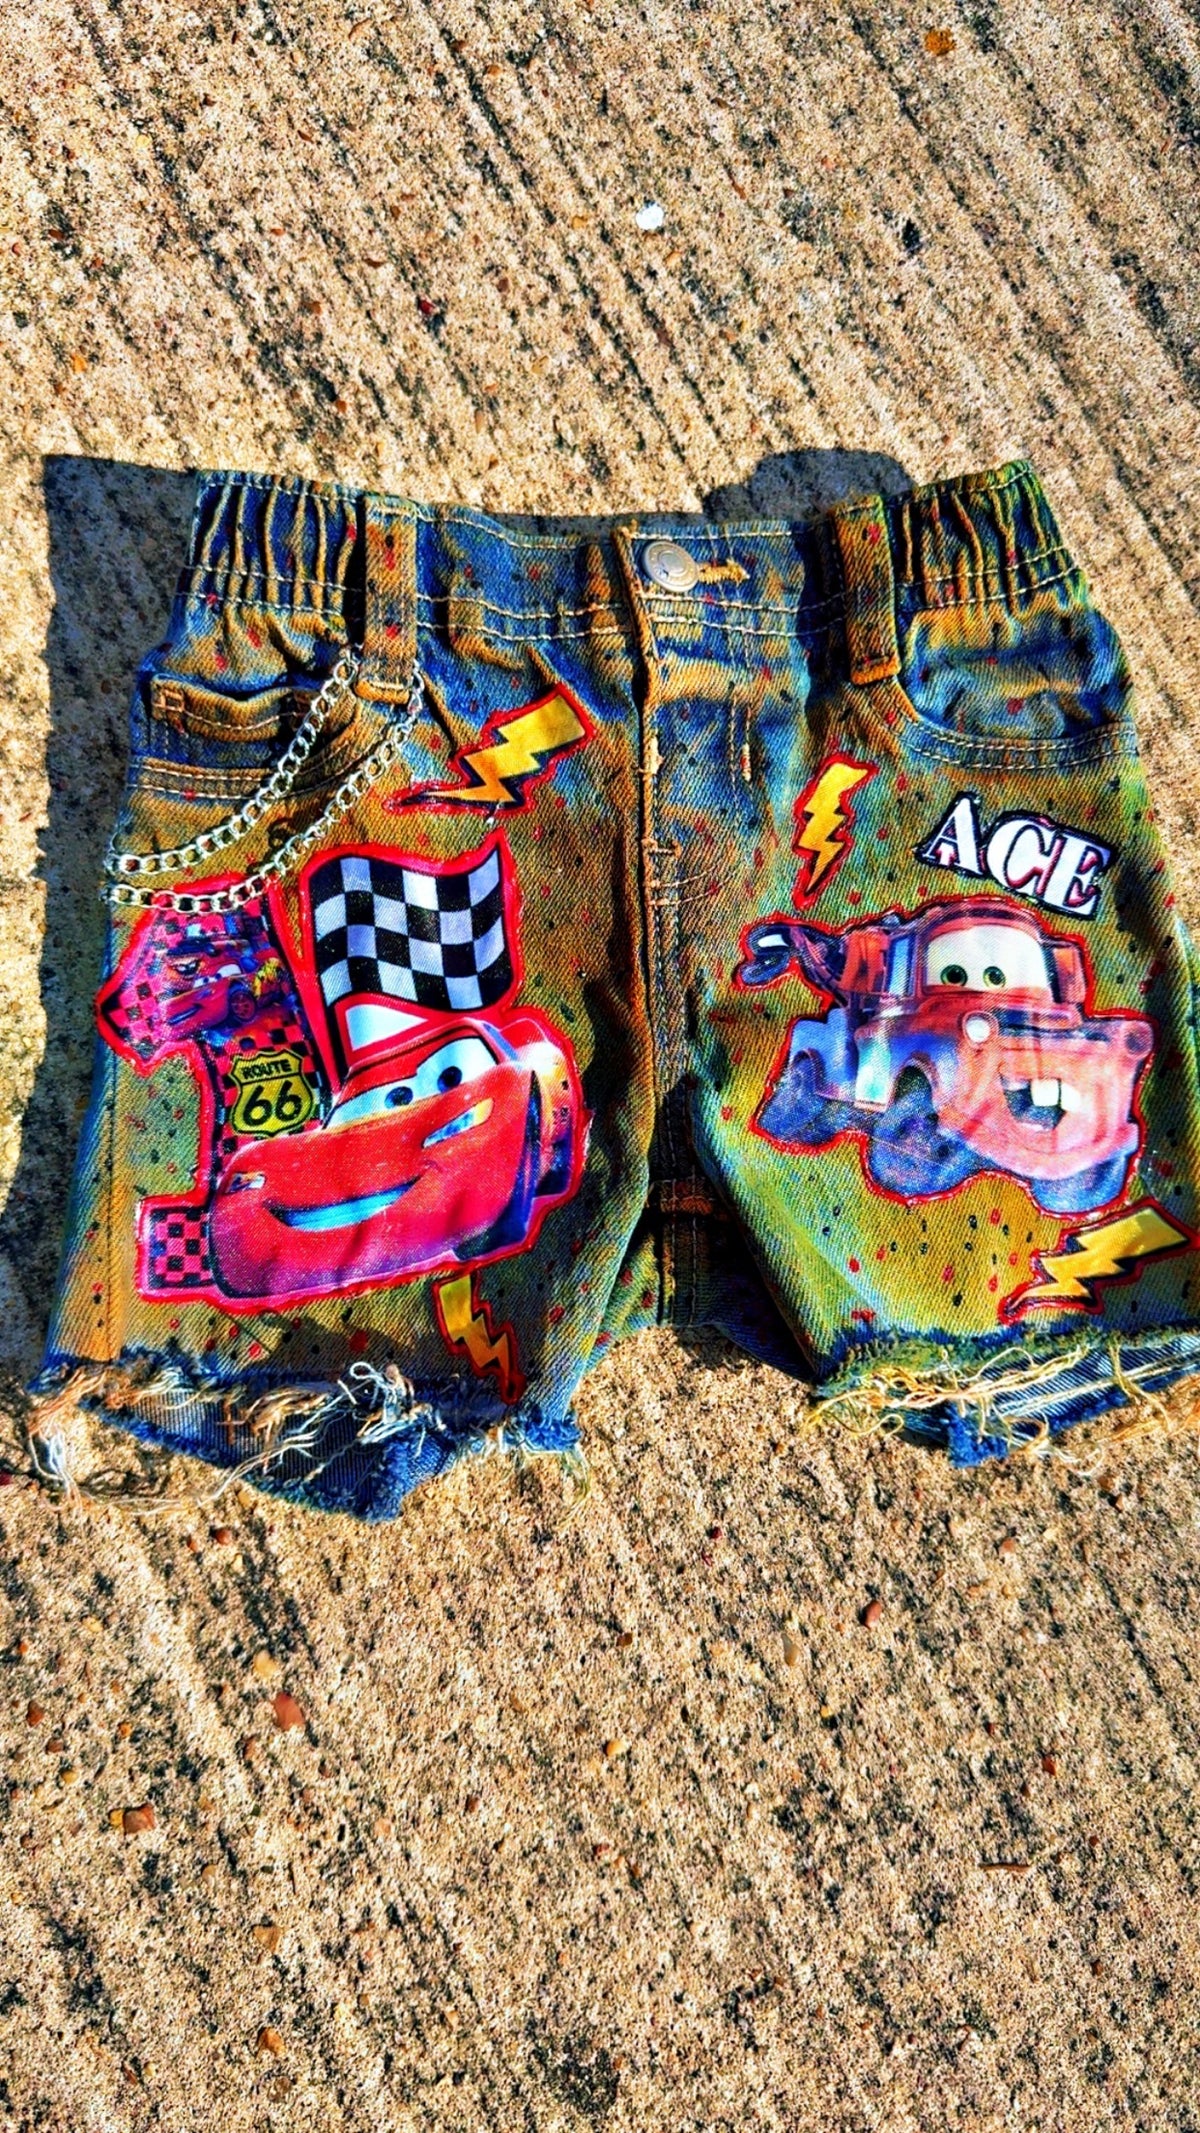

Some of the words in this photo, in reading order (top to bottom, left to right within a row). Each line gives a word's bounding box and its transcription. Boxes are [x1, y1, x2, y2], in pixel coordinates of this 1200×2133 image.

[917, 793, 1115, 918] ACE
[241, 1059, 292, 1080] ROUTE
[242, 1080, 302, 1127] 66
